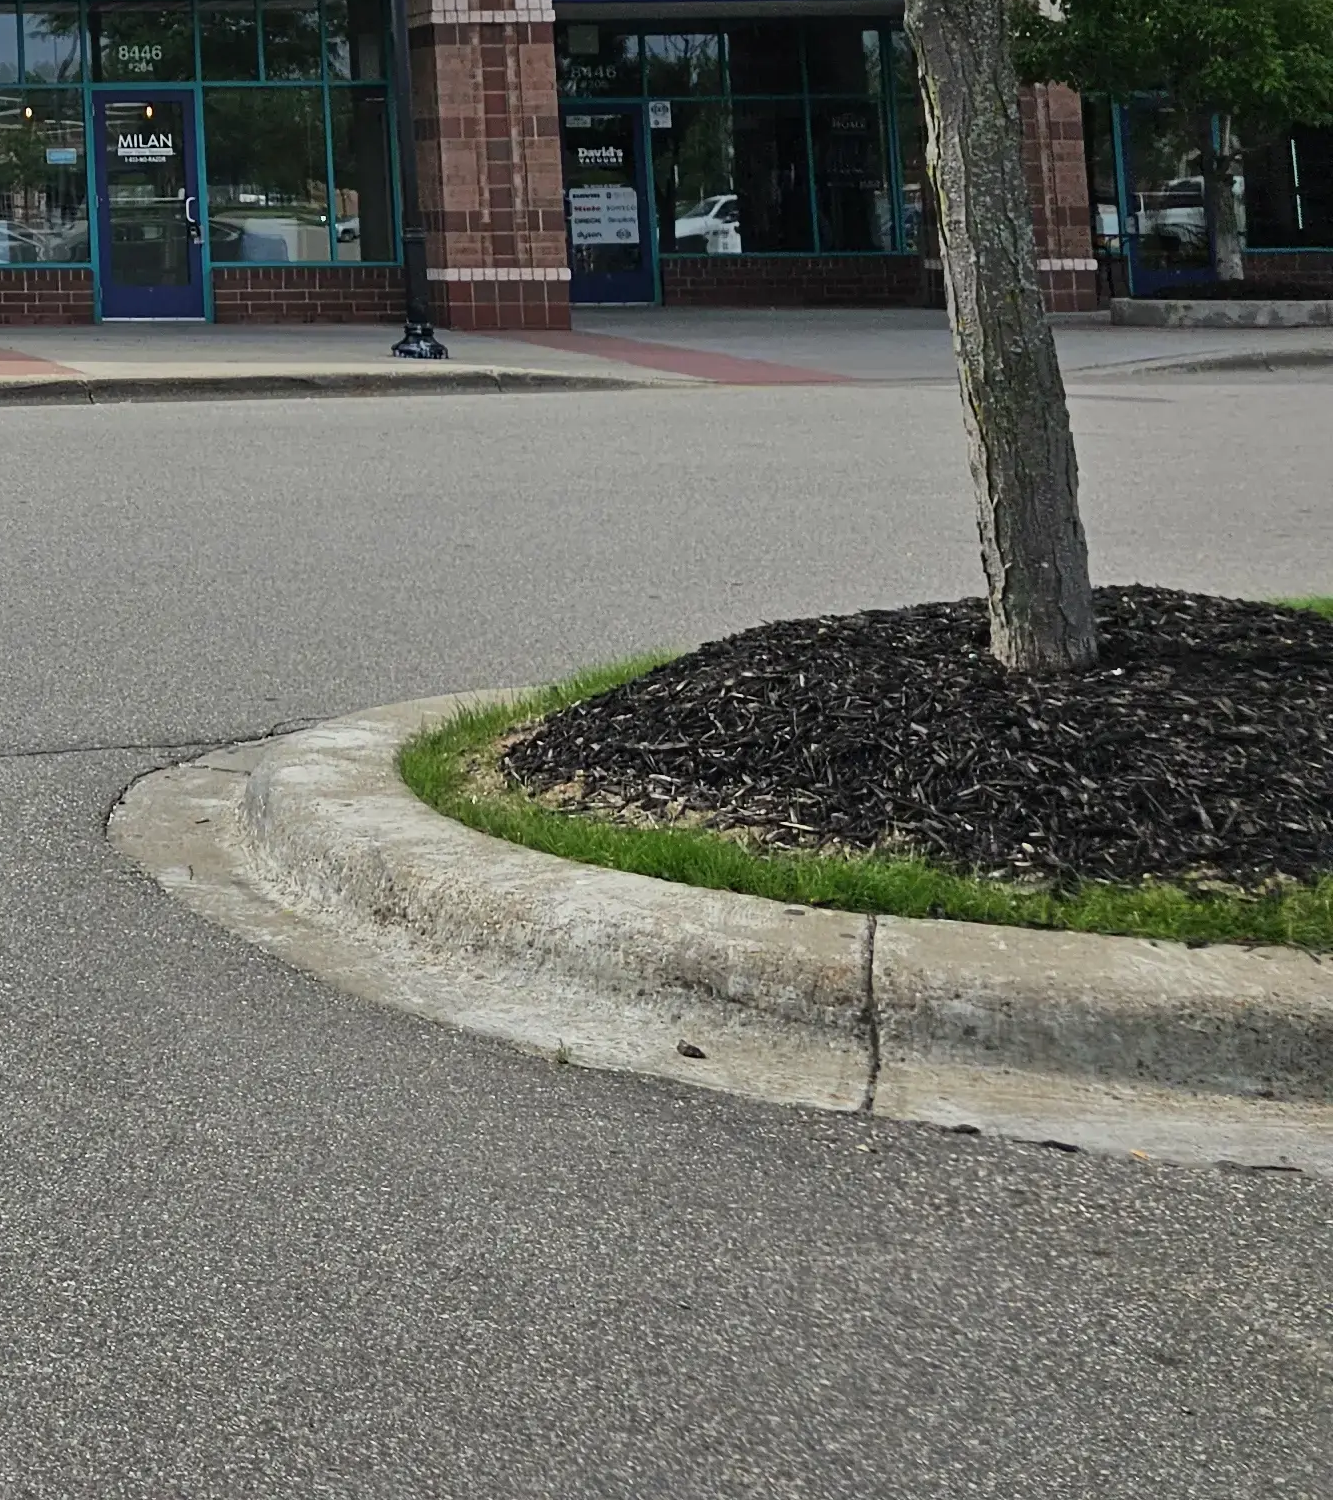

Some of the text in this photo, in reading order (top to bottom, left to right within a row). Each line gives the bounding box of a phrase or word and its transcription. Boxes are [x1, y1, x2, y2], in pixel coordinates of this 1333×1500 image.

[118, 45, 162, 61] 8446
[117, 134, 173, 148] MILAN
[577, 146, 623, 157] David's
